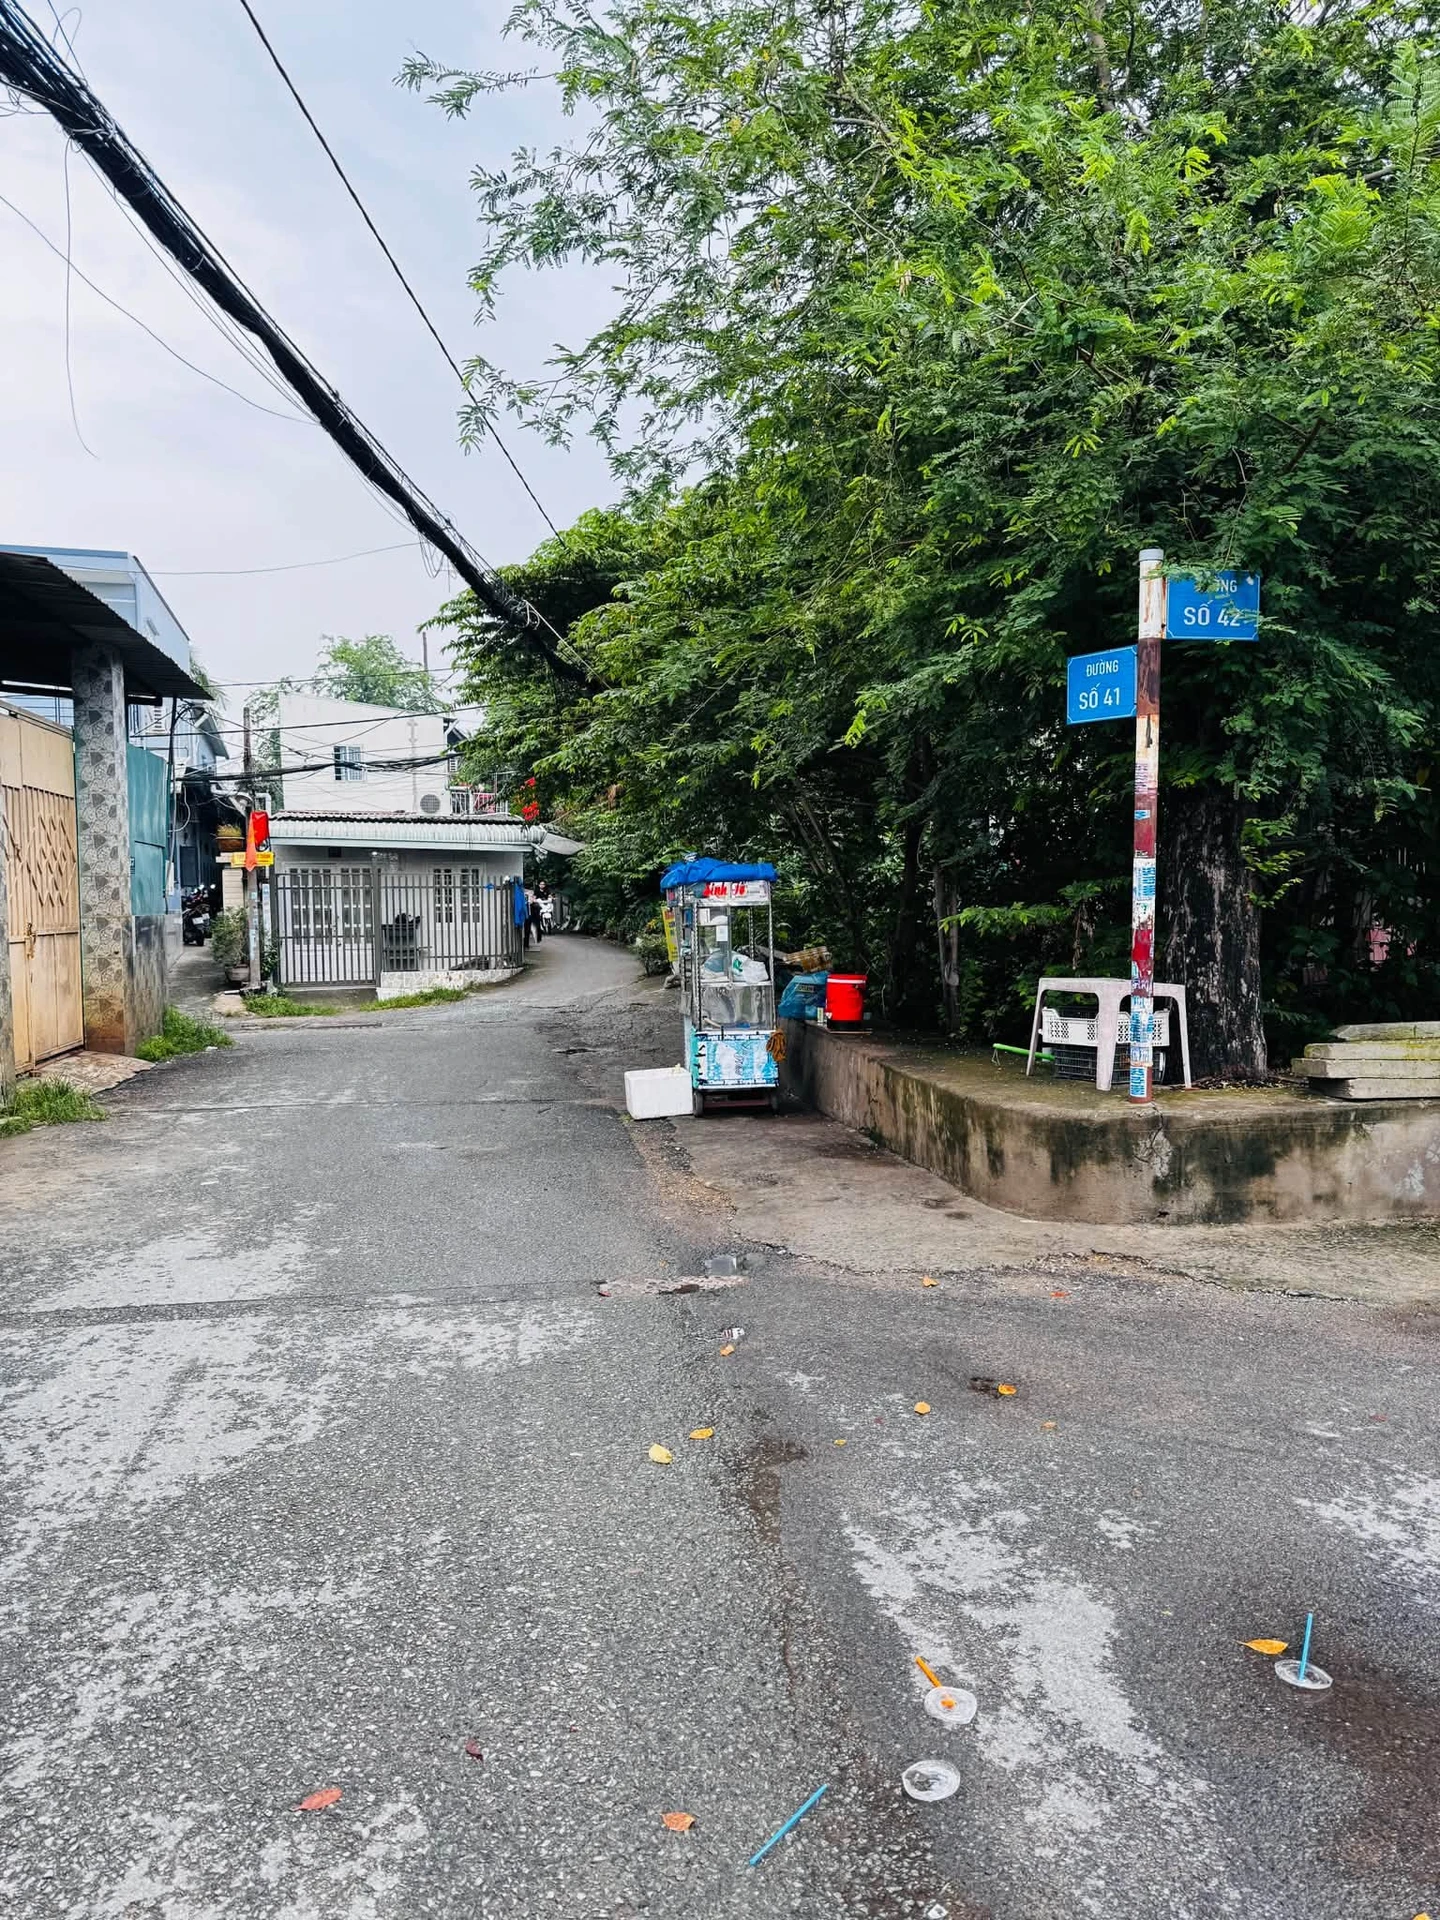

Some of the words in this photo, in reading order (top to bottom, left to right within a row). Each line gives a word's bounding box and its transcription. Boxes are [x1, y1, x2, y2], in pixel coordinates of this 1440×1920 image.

[1183, 599, 1214, 626] SỐ
[1217, 607, 1241, 627] 42
[1086, 659, 1119, 677] ĐƯỜNG
[1079, 682, 1101, 710] SỐ
[1103, 687, 1120, 706] 41
